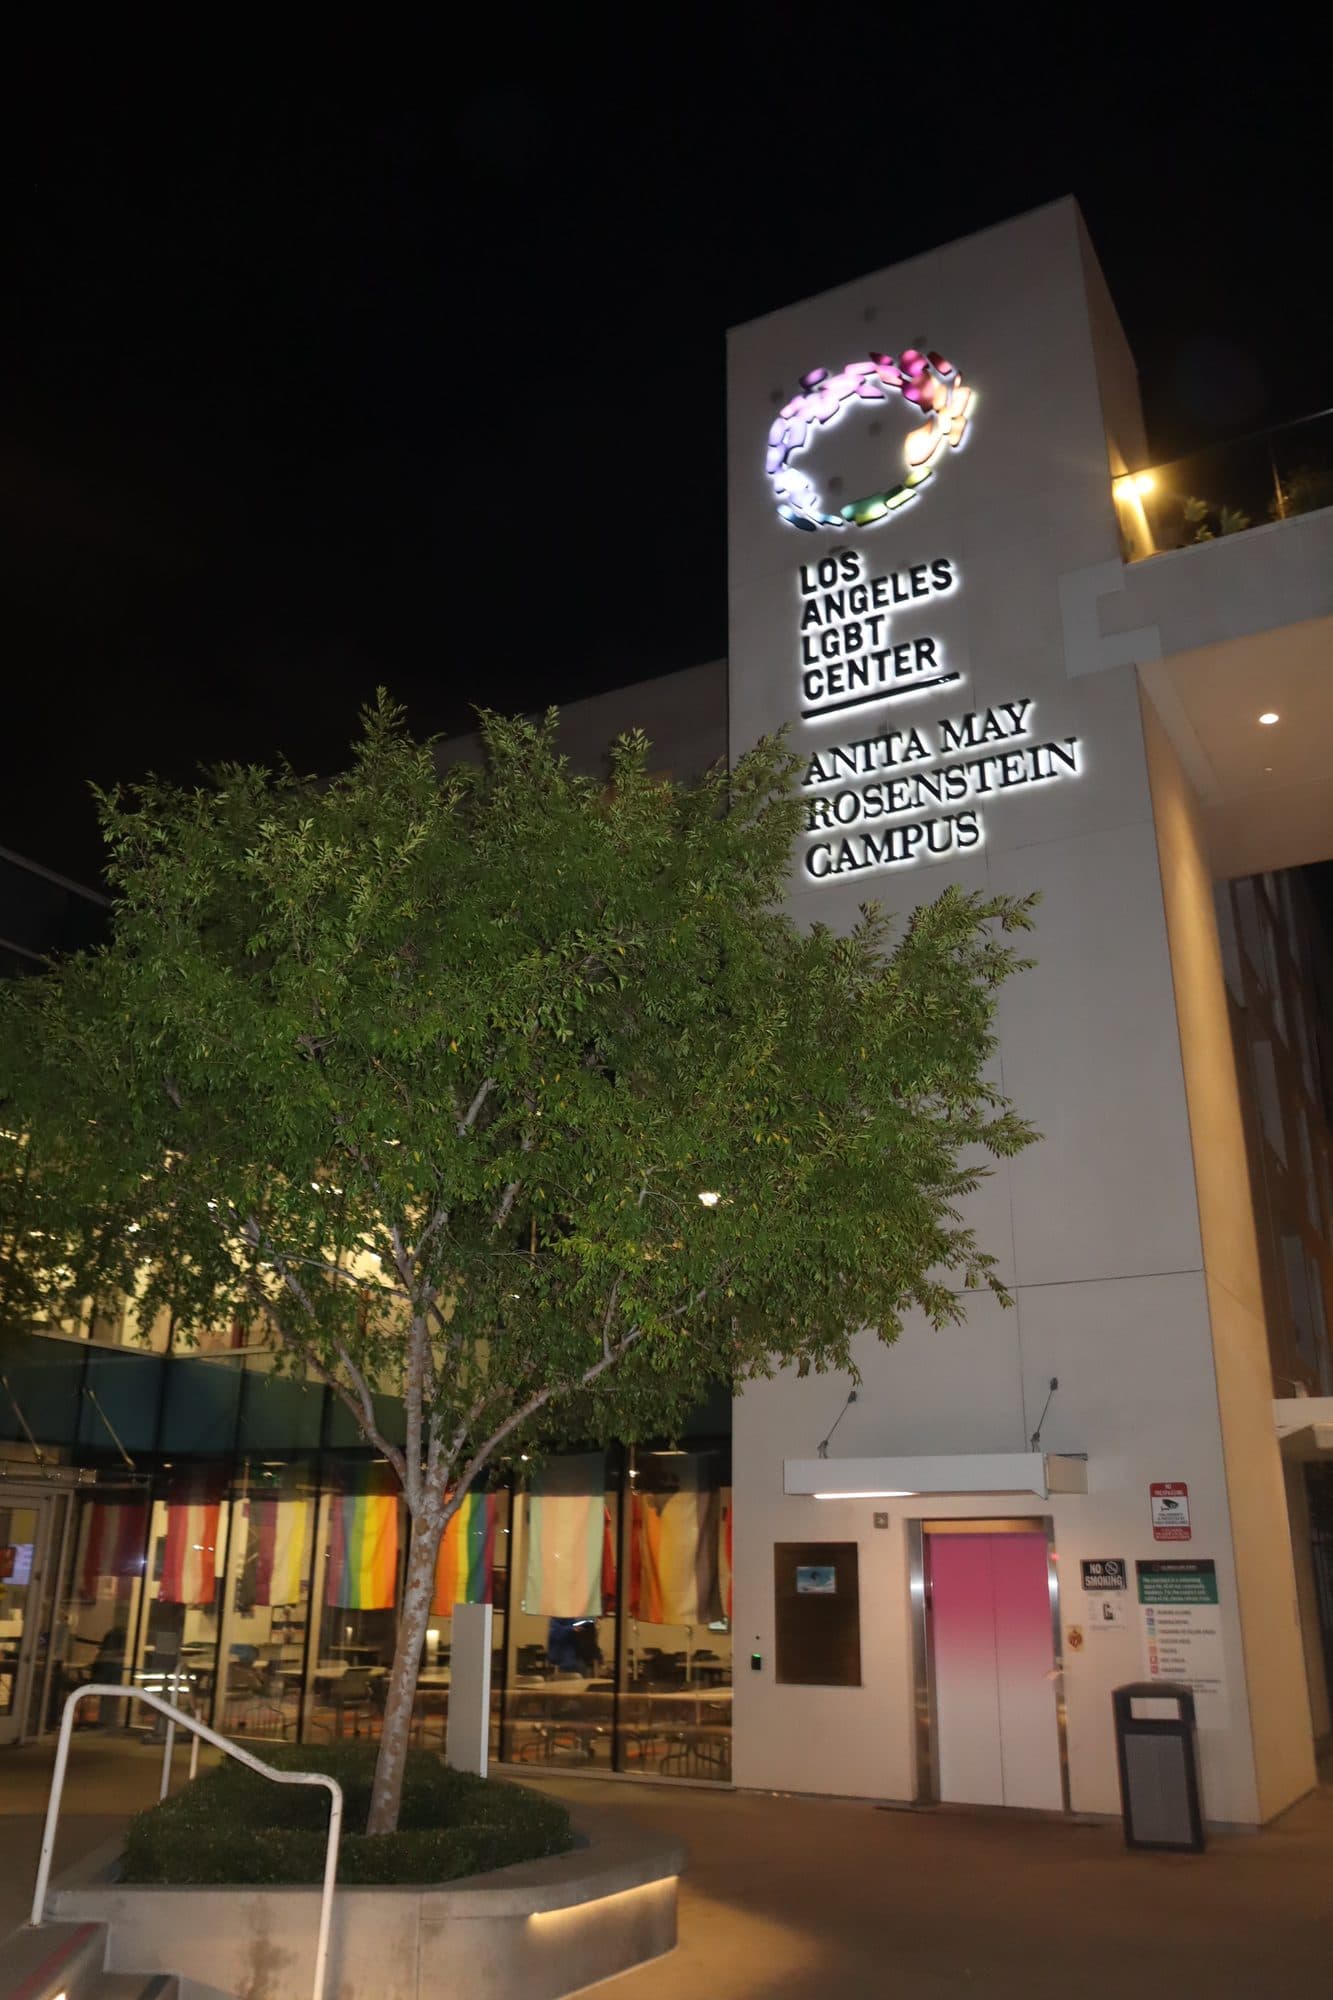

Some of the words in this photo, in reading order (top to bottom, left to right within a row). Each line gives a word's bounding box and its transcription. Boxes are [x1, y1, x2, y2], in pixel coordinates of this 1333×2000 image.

[800, 551, 860, 595] LOS
[801, 558, 953, 630] ANGELES
[802, 614, 886, 666] LGBT
[802, 637, 938, 701] CENTER
[801, 727, 931, 786] ANITA
[938, 698, 1031, 753] MAY
[806, 737, 1078, 831] ROSENSTEIN
[805, 811, 980, 878] CAMPUS
[1085, 1575, 1123, 1587] SMOKING
[1089, 1563, 1101, 1574] NO
